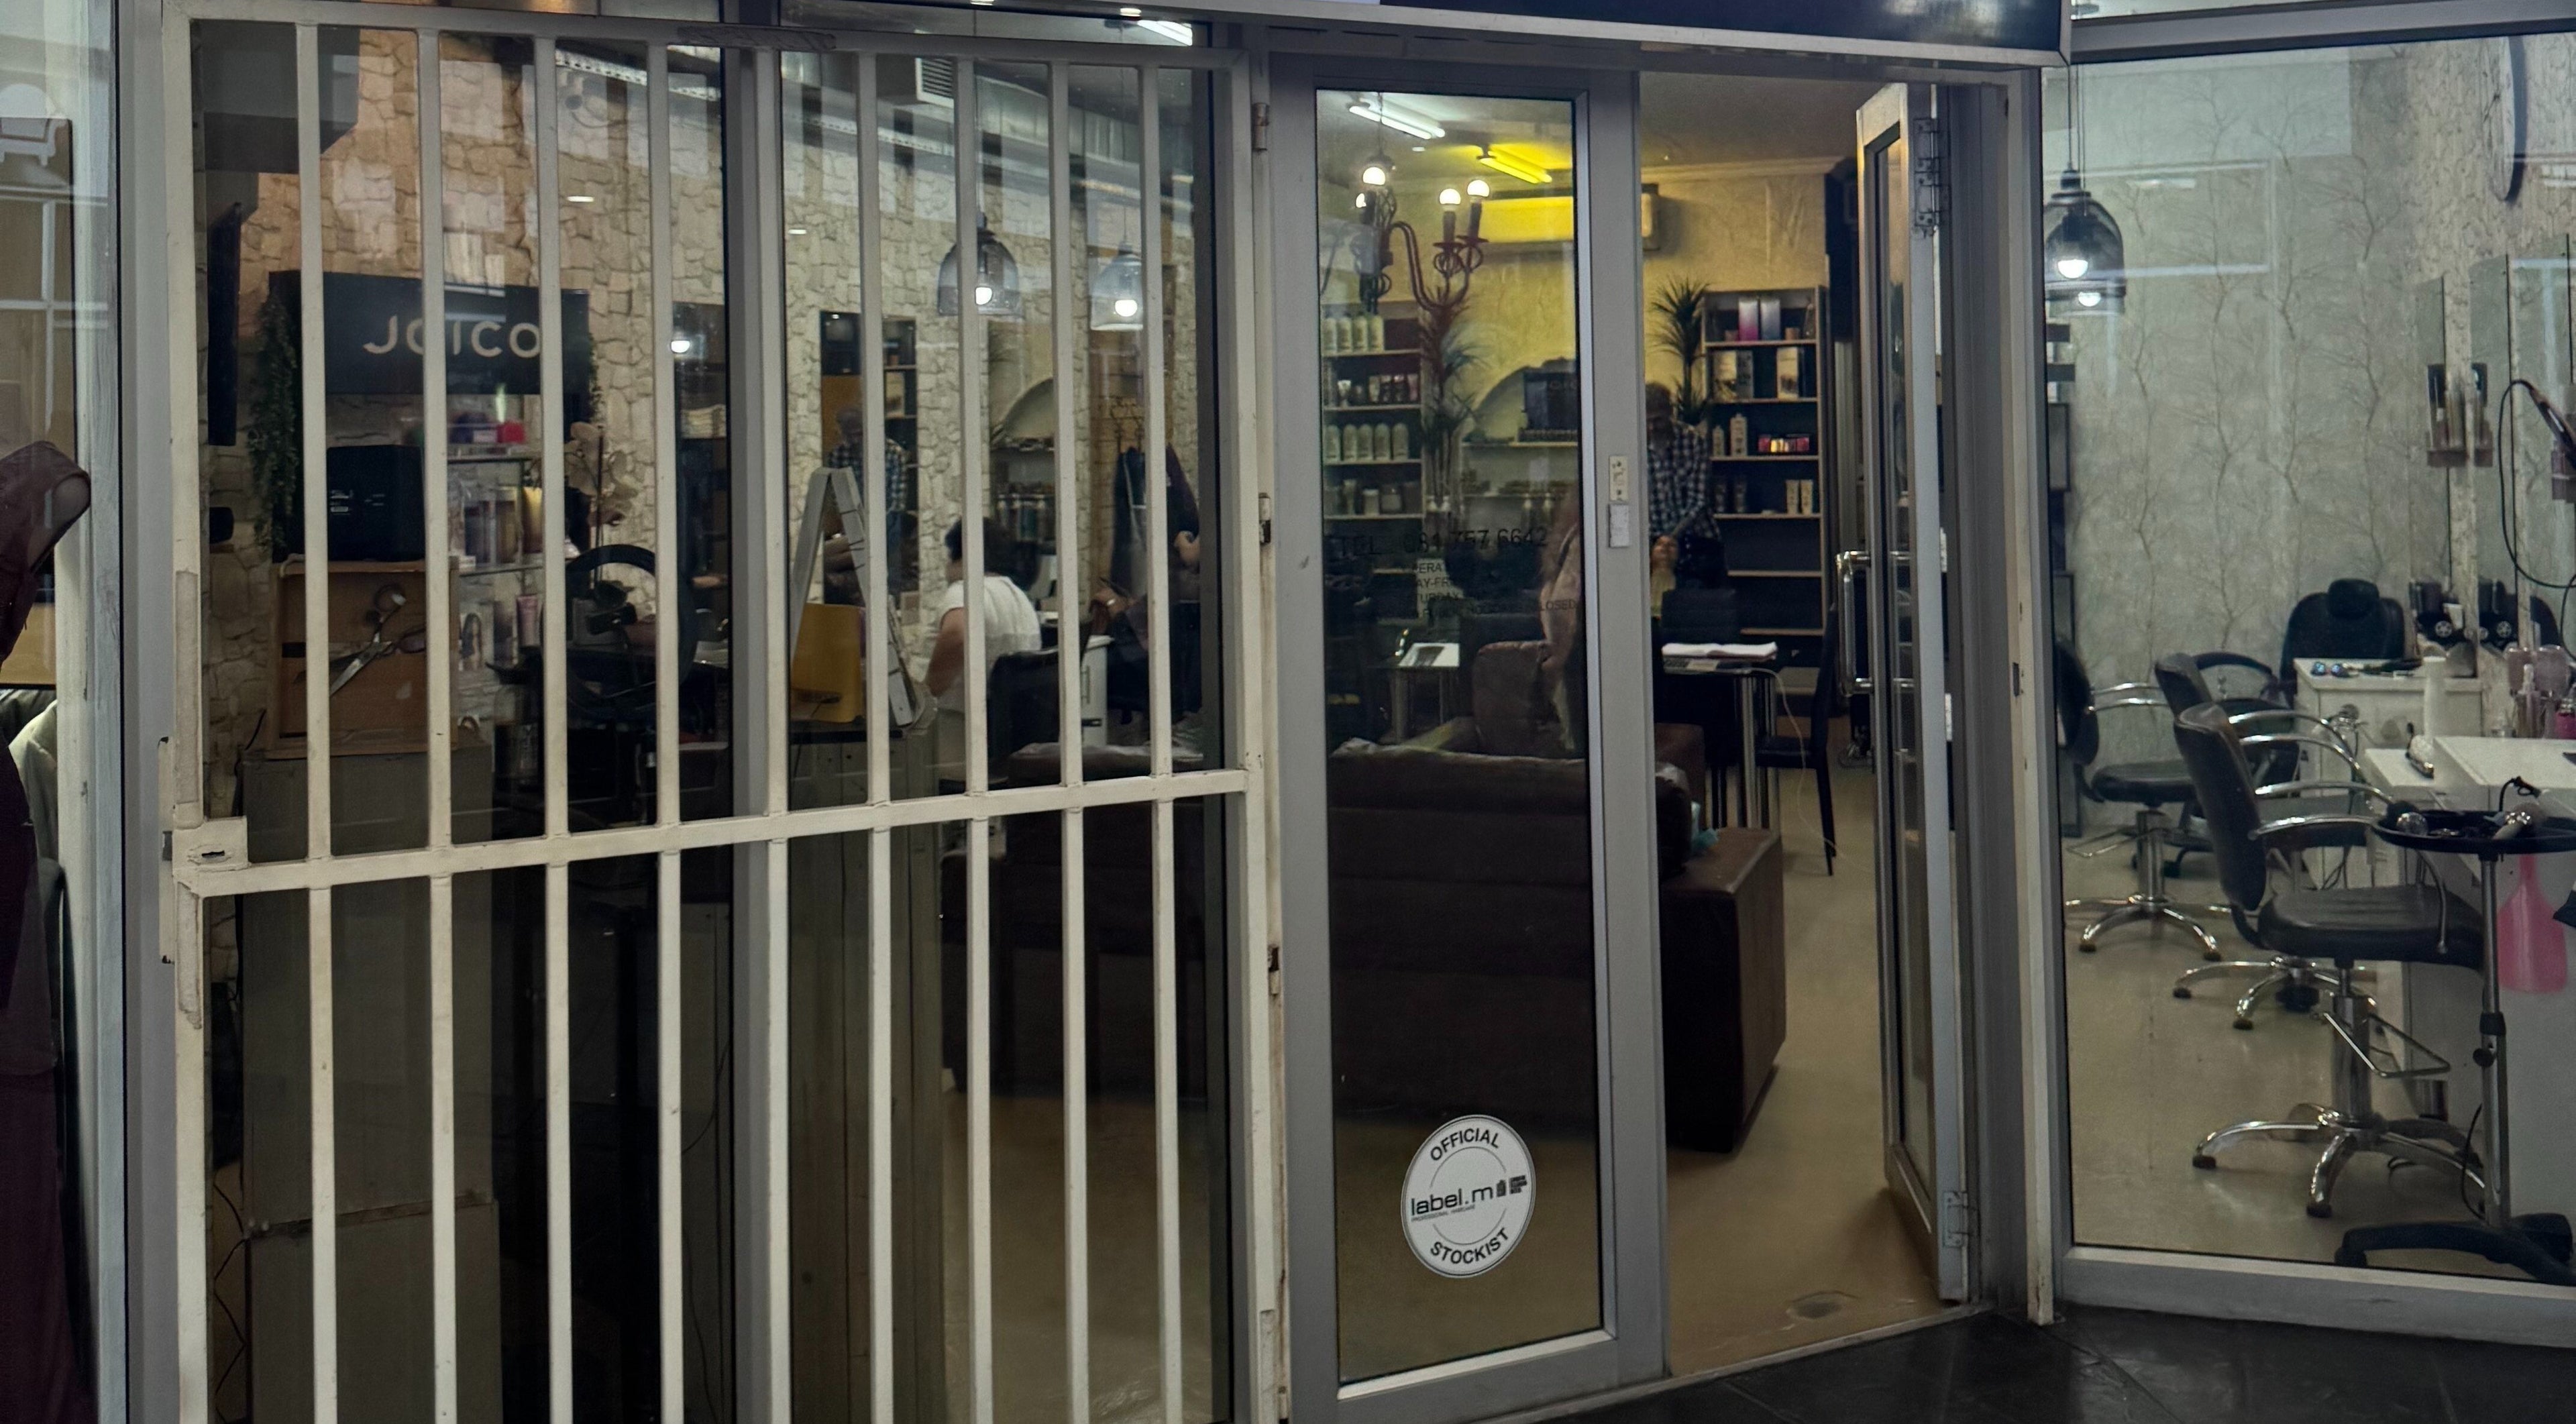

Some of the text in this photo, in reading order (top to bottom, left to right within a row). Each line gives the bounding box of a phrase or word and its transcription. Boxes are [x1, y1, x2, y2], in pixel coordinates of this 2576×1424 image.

[1430, 1128, 1501, 1161] OFFICIAL
[1411, 1187, 1493, 1216] label.m
[1430, 1227, 1509, 1264] STOCKIST
